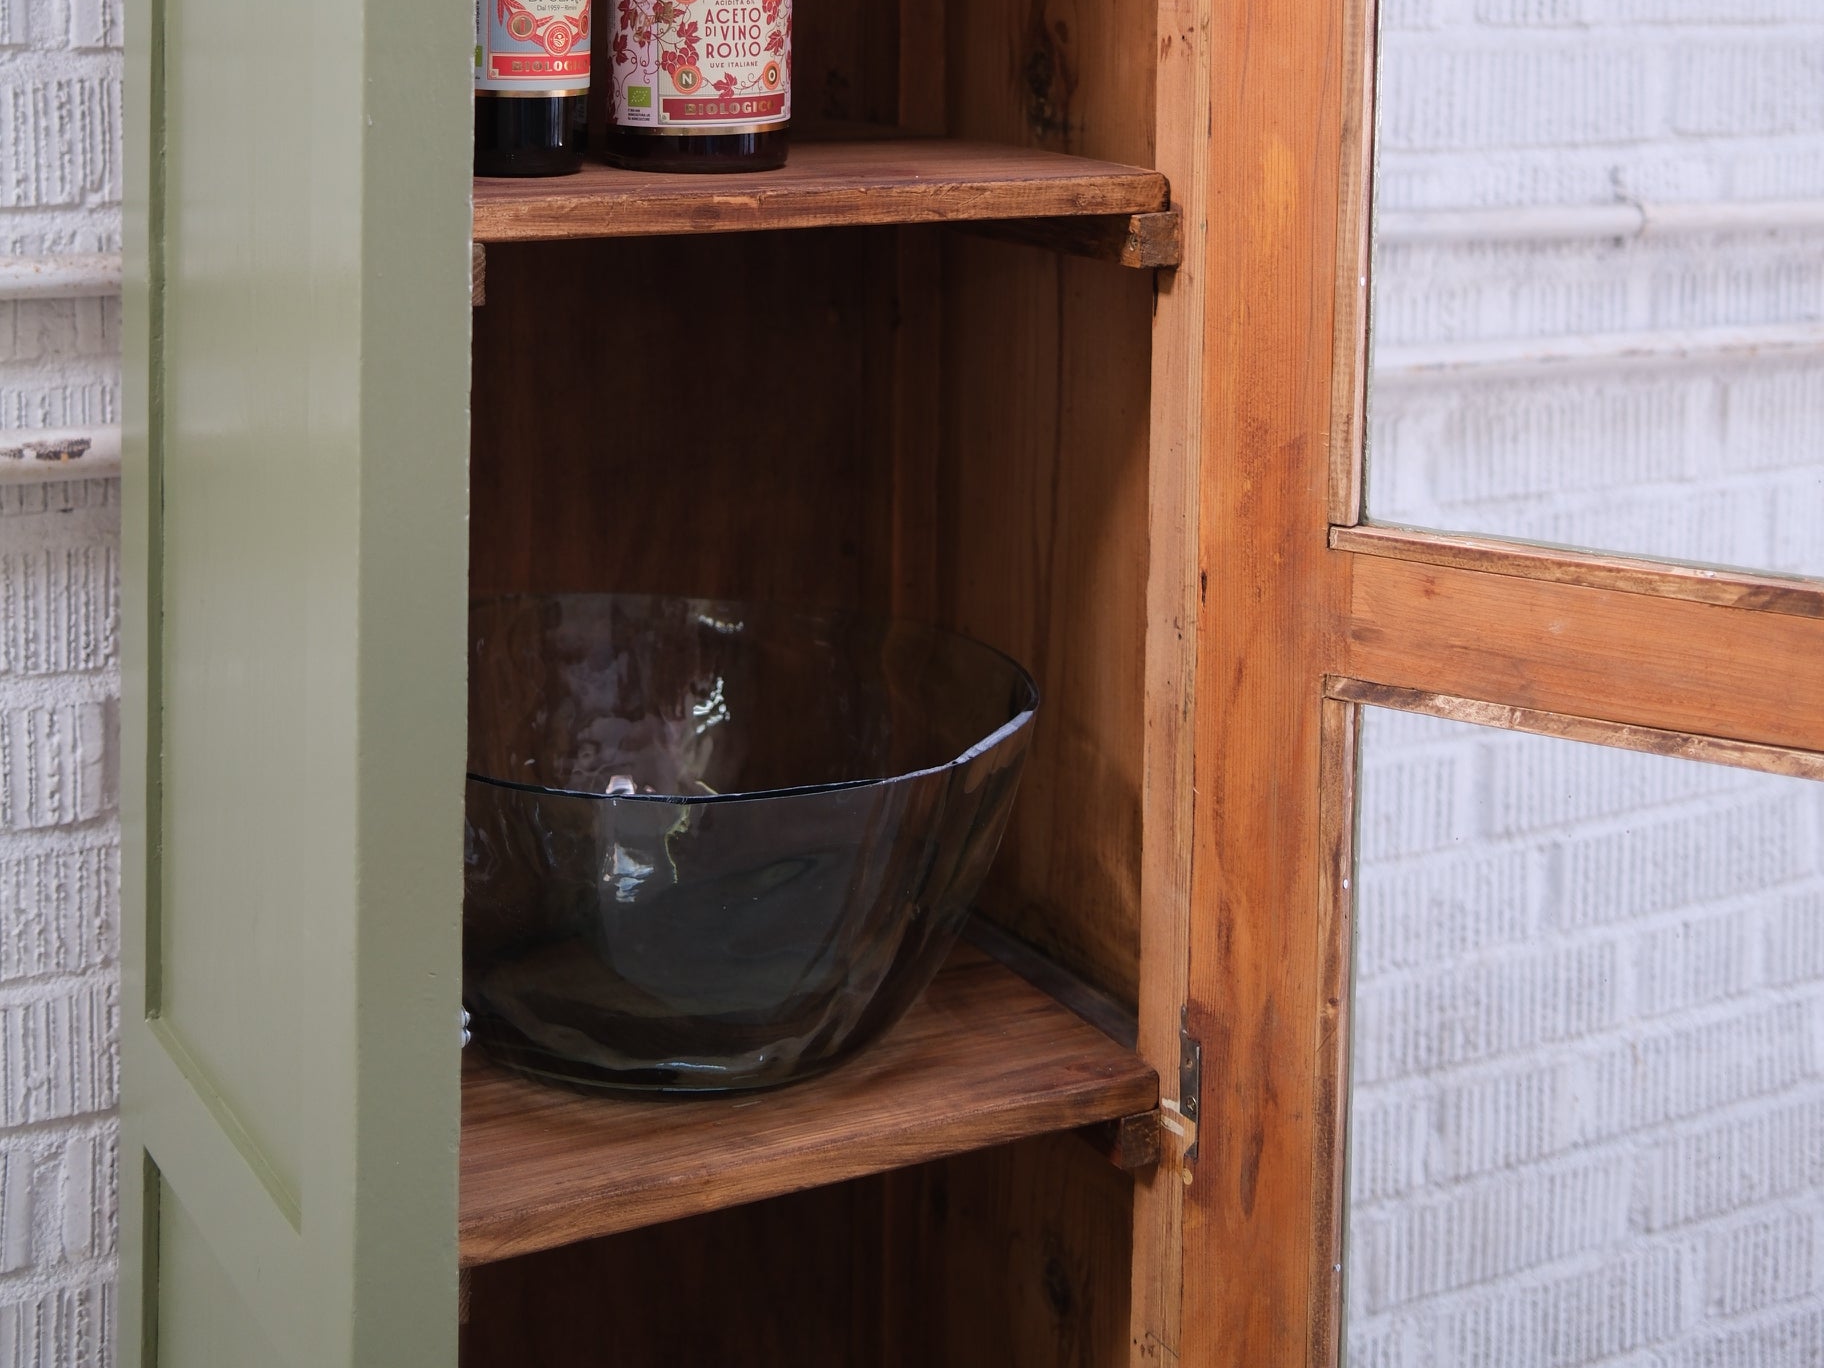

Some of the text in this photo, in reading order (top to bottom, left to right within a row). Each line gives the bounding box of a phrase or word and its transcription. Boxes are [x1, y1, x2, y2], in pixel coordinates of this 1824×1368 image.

[704, 7, 761, 25] ACETO
[705, 25, 761, 41] DI VINO
[706, 41, 761, 59] ROSSO
[727, 60, 759, 68] ITALIANE
[684, 99, 774, 116] BIOLOGICO
